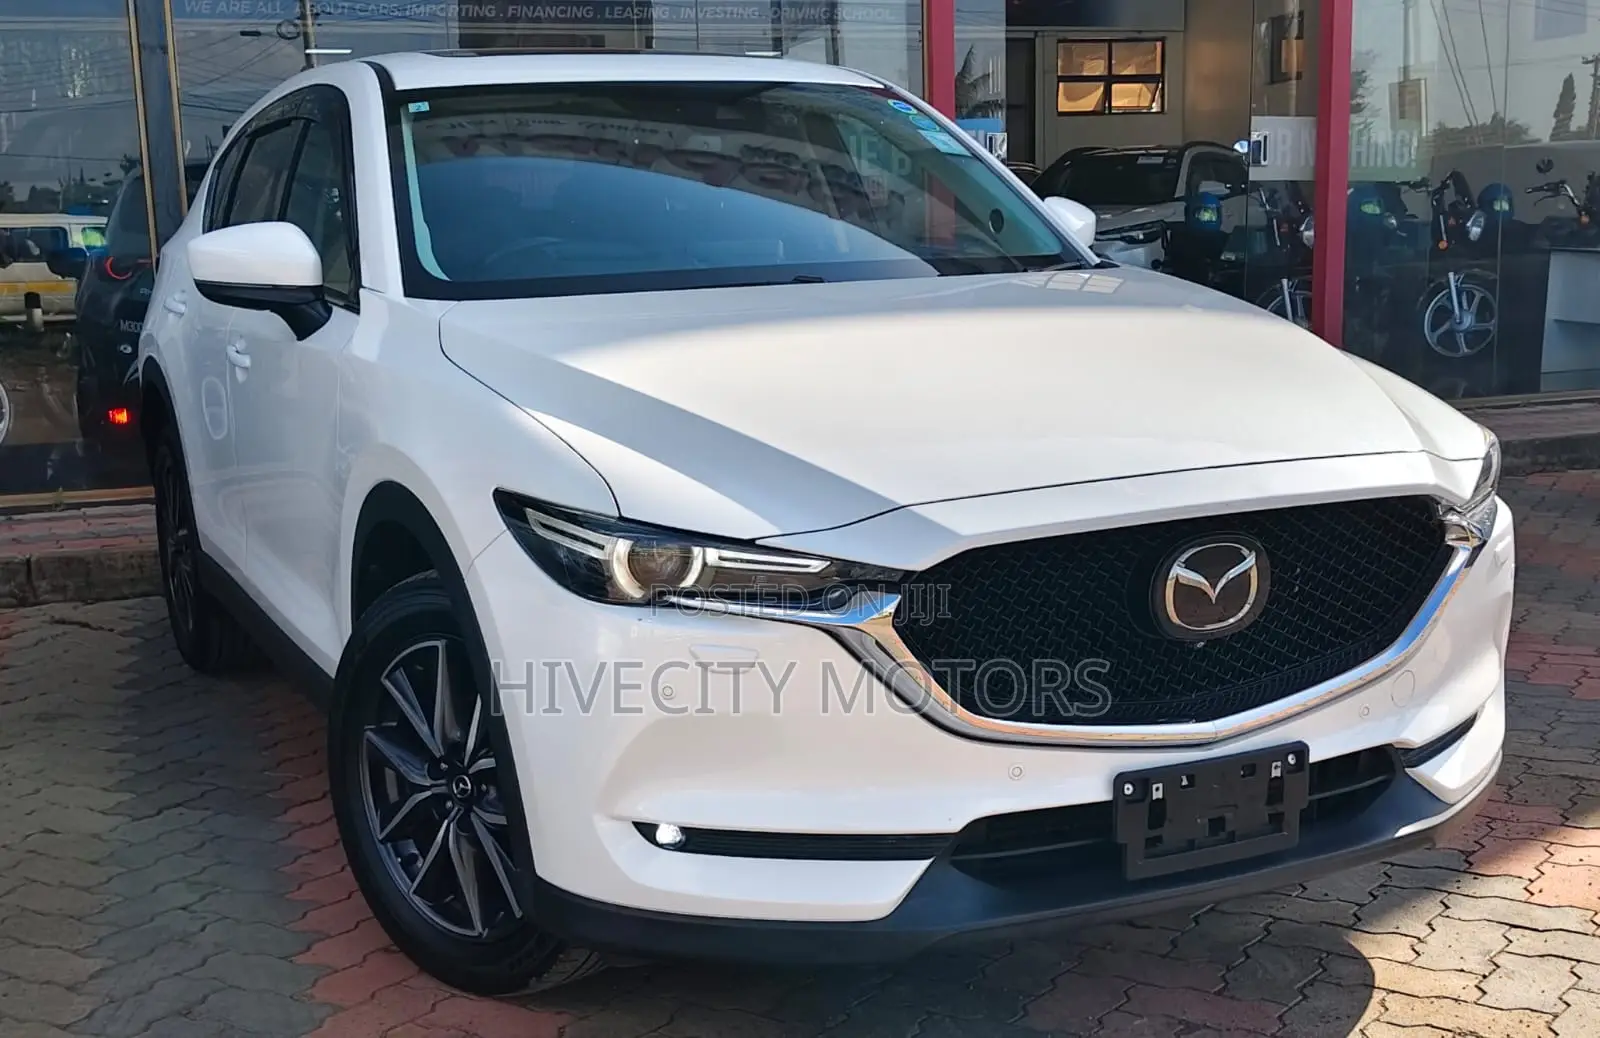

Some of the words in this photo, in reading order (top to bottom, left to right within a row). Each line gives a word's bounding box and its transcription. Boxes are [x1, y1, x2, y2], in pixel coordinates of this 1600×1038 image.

[184, 1, 207, 14] WE
[215, 1, 255, 14] ARE
[257, 1, 285, 15] ALL
[506, 4, 595, 19] FINANCING
[604, 5, 670, 19] LEASING
[679, 6, 761, 20] INVESTING
[769, 7, 831, 20] DRIVING
